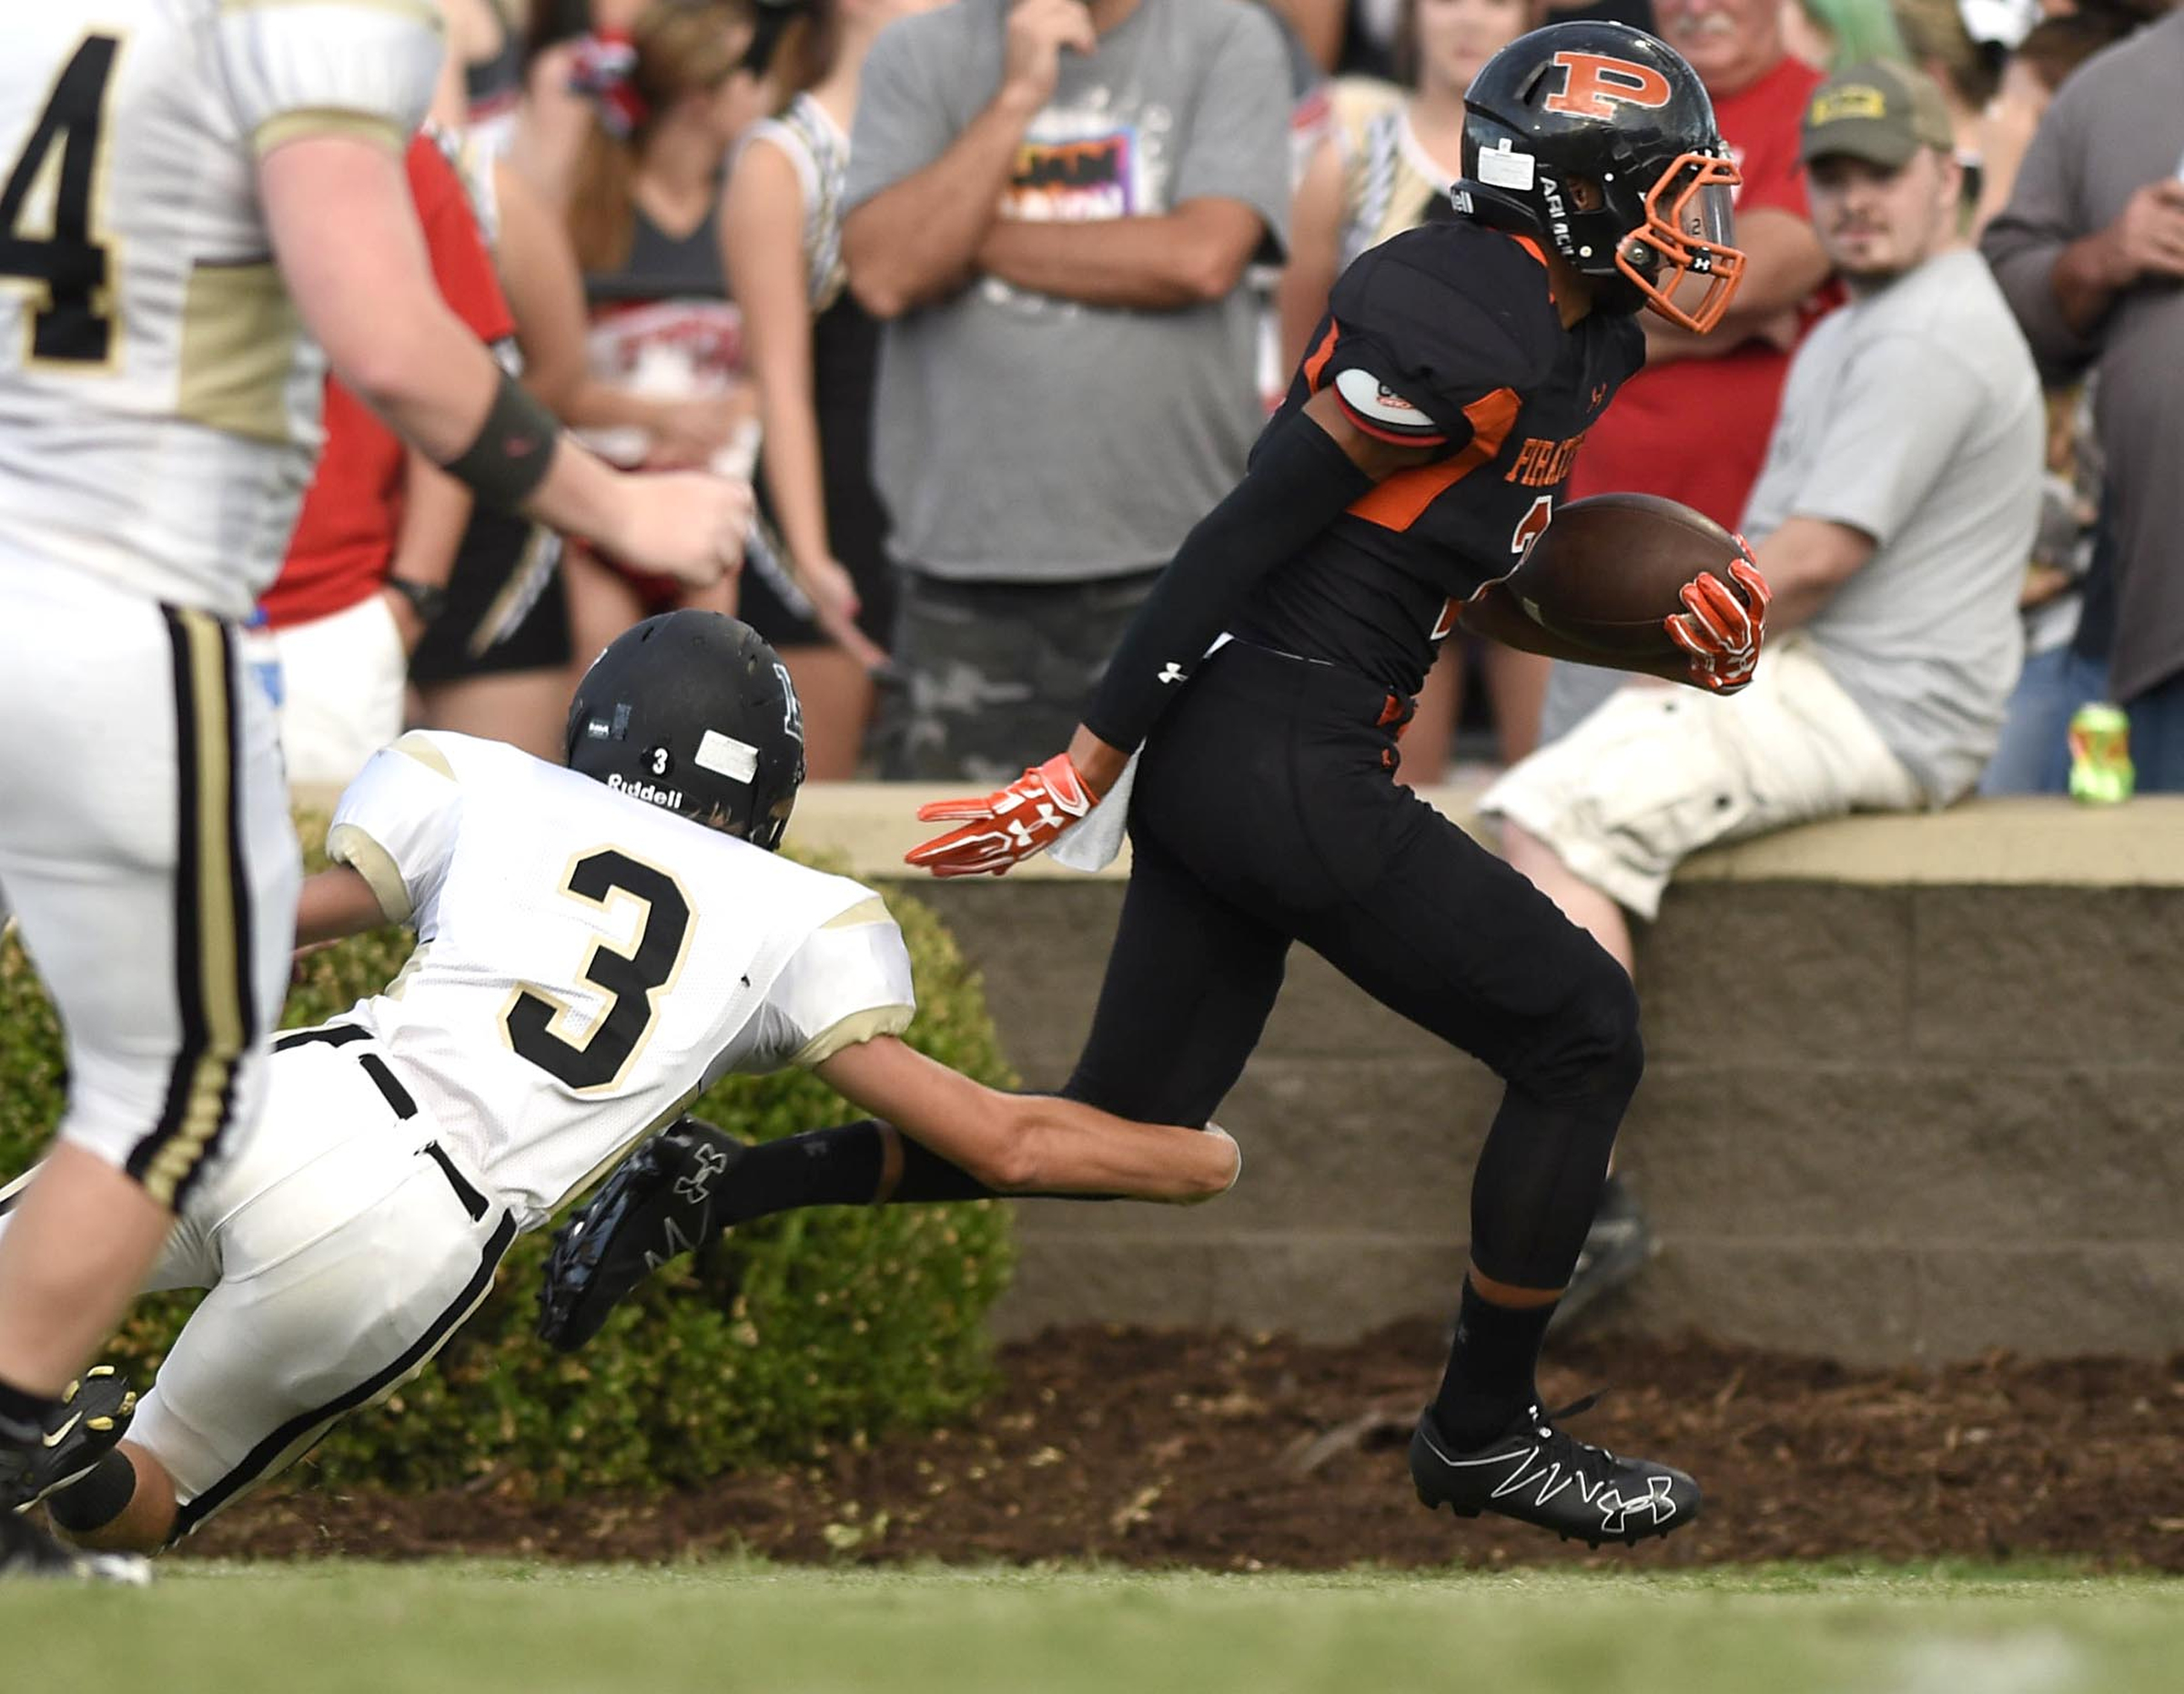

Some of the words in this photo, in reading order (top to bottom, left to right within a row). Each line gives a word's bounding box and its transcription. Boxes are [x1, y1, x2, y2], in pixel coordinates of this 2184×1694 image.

[1544, 51, 1672, 121] P
[0, 25, 127, 373] 4
[1692, 217, 1702, 236] 2
[652, 747, 669, 775] 3
[608, 773, 682, 810] Riddell
[498, 843, 698, 1092] 3
